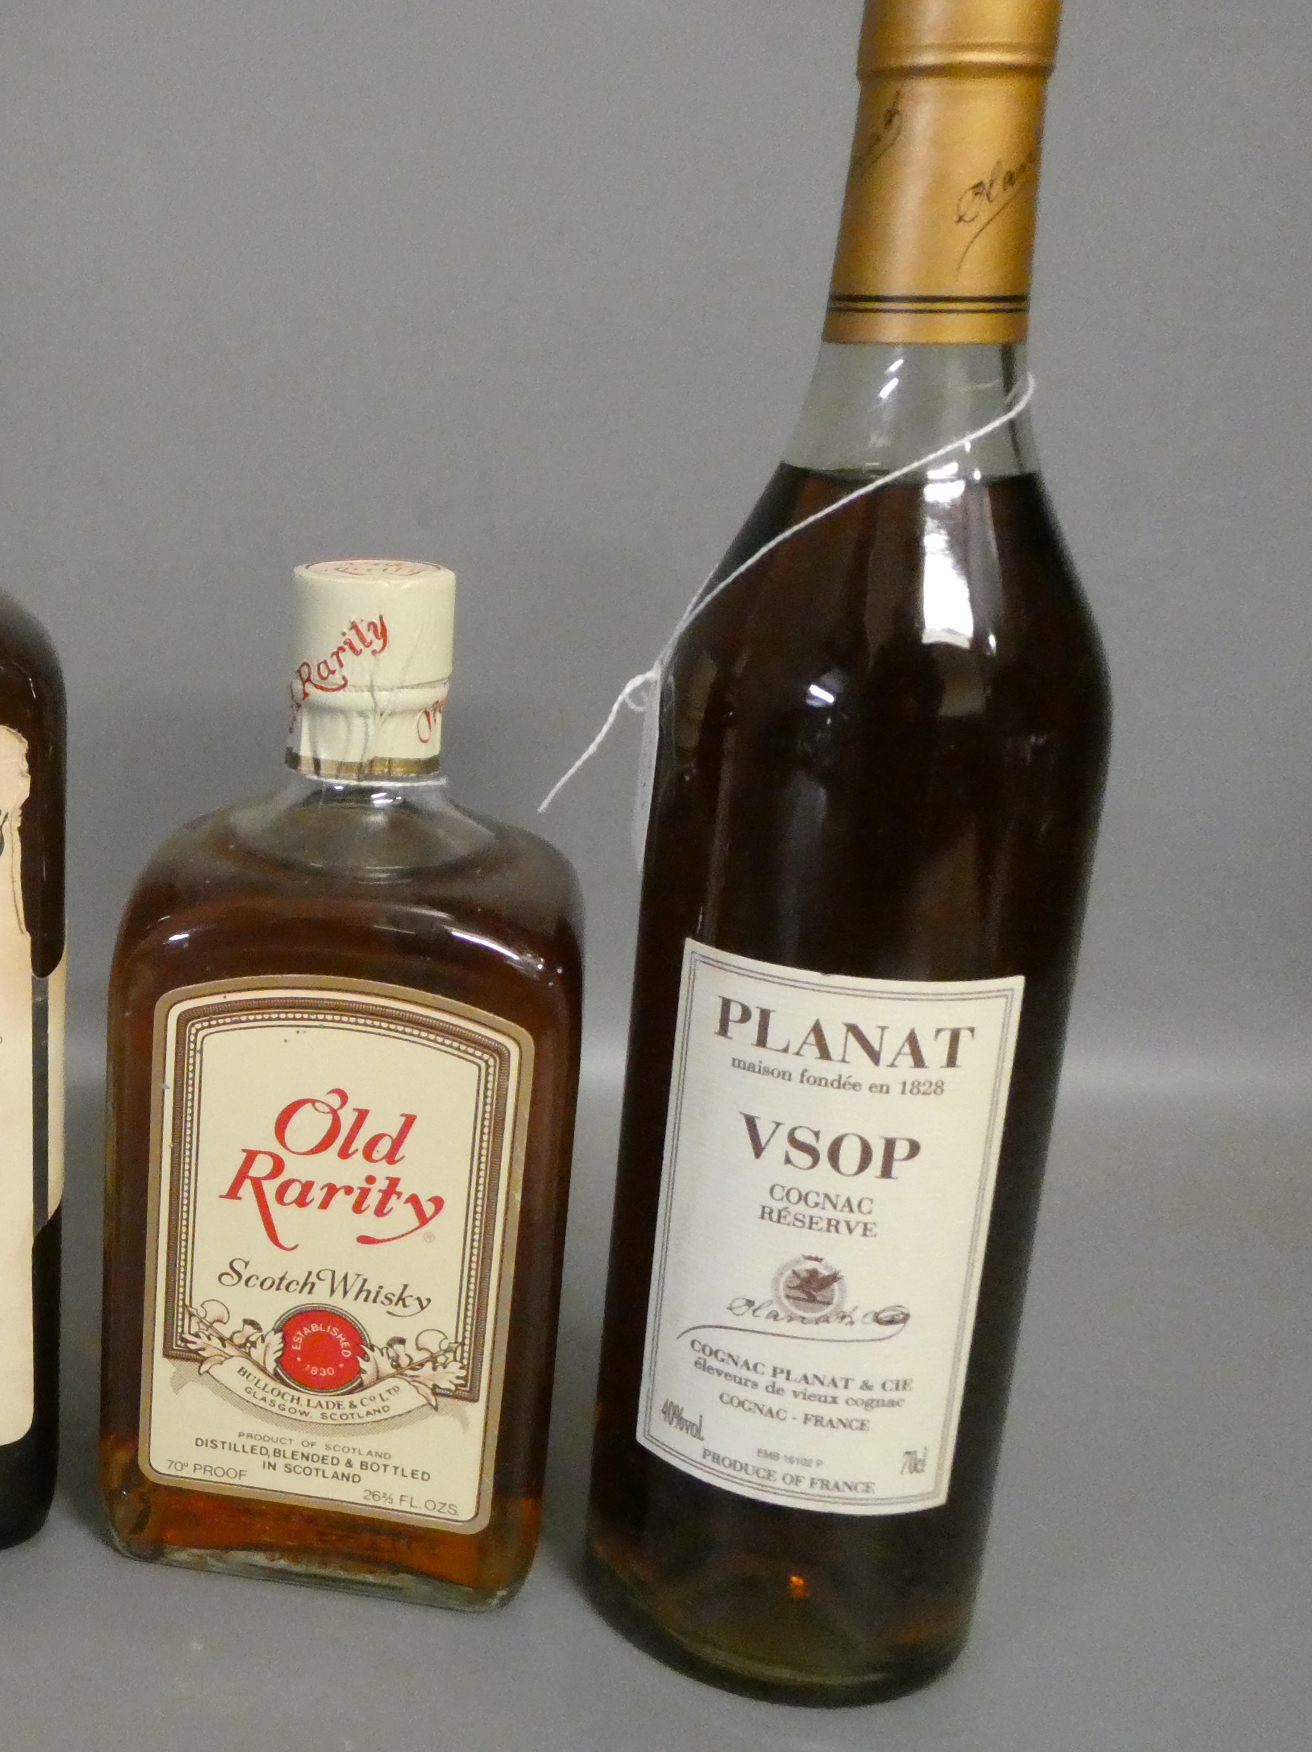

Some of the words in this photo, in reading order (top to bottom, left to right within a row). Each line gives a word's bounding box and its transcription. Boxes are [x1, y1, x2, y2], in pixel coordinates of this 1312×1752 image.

[296, 614, 388, 701] Rarity
[713, 994, 977, 1070] PLANAT
[731, 1054, 793, 1083] maison
[798, 1068, 863, 1095] fondée
[868, 1082, 891, 1096] en
[899, 1079, 946, 1097] 1828
[273, 1087, 418, 1166] Old
[738, 1110, 922, 1181] VSOP
[218, 1148, 446, 1252] Rarity
[768, 1183, 874, 1216] COGNAC
[758, 1205, 879, 1239] RÉSERVE
[217, 1257, 317, 1296] Scotch
[314, 1267, 432, 1319] Whisky
[291, 1322, 352, 1358] ESTABLISHED
[304, 1362, 336, 1377] 1830
[689, 1338, 767, 1376] COGNAC
[771, 1366, 854, 1392] PLANAT
[859, 1379, 874, 1393] &
[880, 1377, 914, 1393] CIE
[693, 1356, 759, 1390] éleveurs
[765, 1380, 785, 1397] de
[791, 1388, 839, 1406] vieux
[845, 1395, 906, 1411] cognac
[306, 1398, 346, 1411] LADE
[349, 1399, 358, 1410] &
[319, 1403, 392, 1422] SCOTLAND
[718, 1391, 788, 1422] COGNAC
[803, 1412, 871, 1432] FRANCE
[237, 1431, 295, 1446] PRODUCT
[301, 1439, 318, 1449] OF
[324, 1444, 392, 1461] SCOTLAND
[272, 1447, 341, 1467] BLENDED
[345, 1458, 354, 1469] &
[359, 1460, 431, 1483] BOTTLED
[192, 1463, 249, 1482] PROOF
[262, 1460, 277, 1472] IN
[283, 1462, 363, 1485] SCOTLAND
[701, 1448, 778, 1483] PRODUCE
[782, 1471, 806, 1487] OF
[809, 1474, 876, 1495] FRANCE
